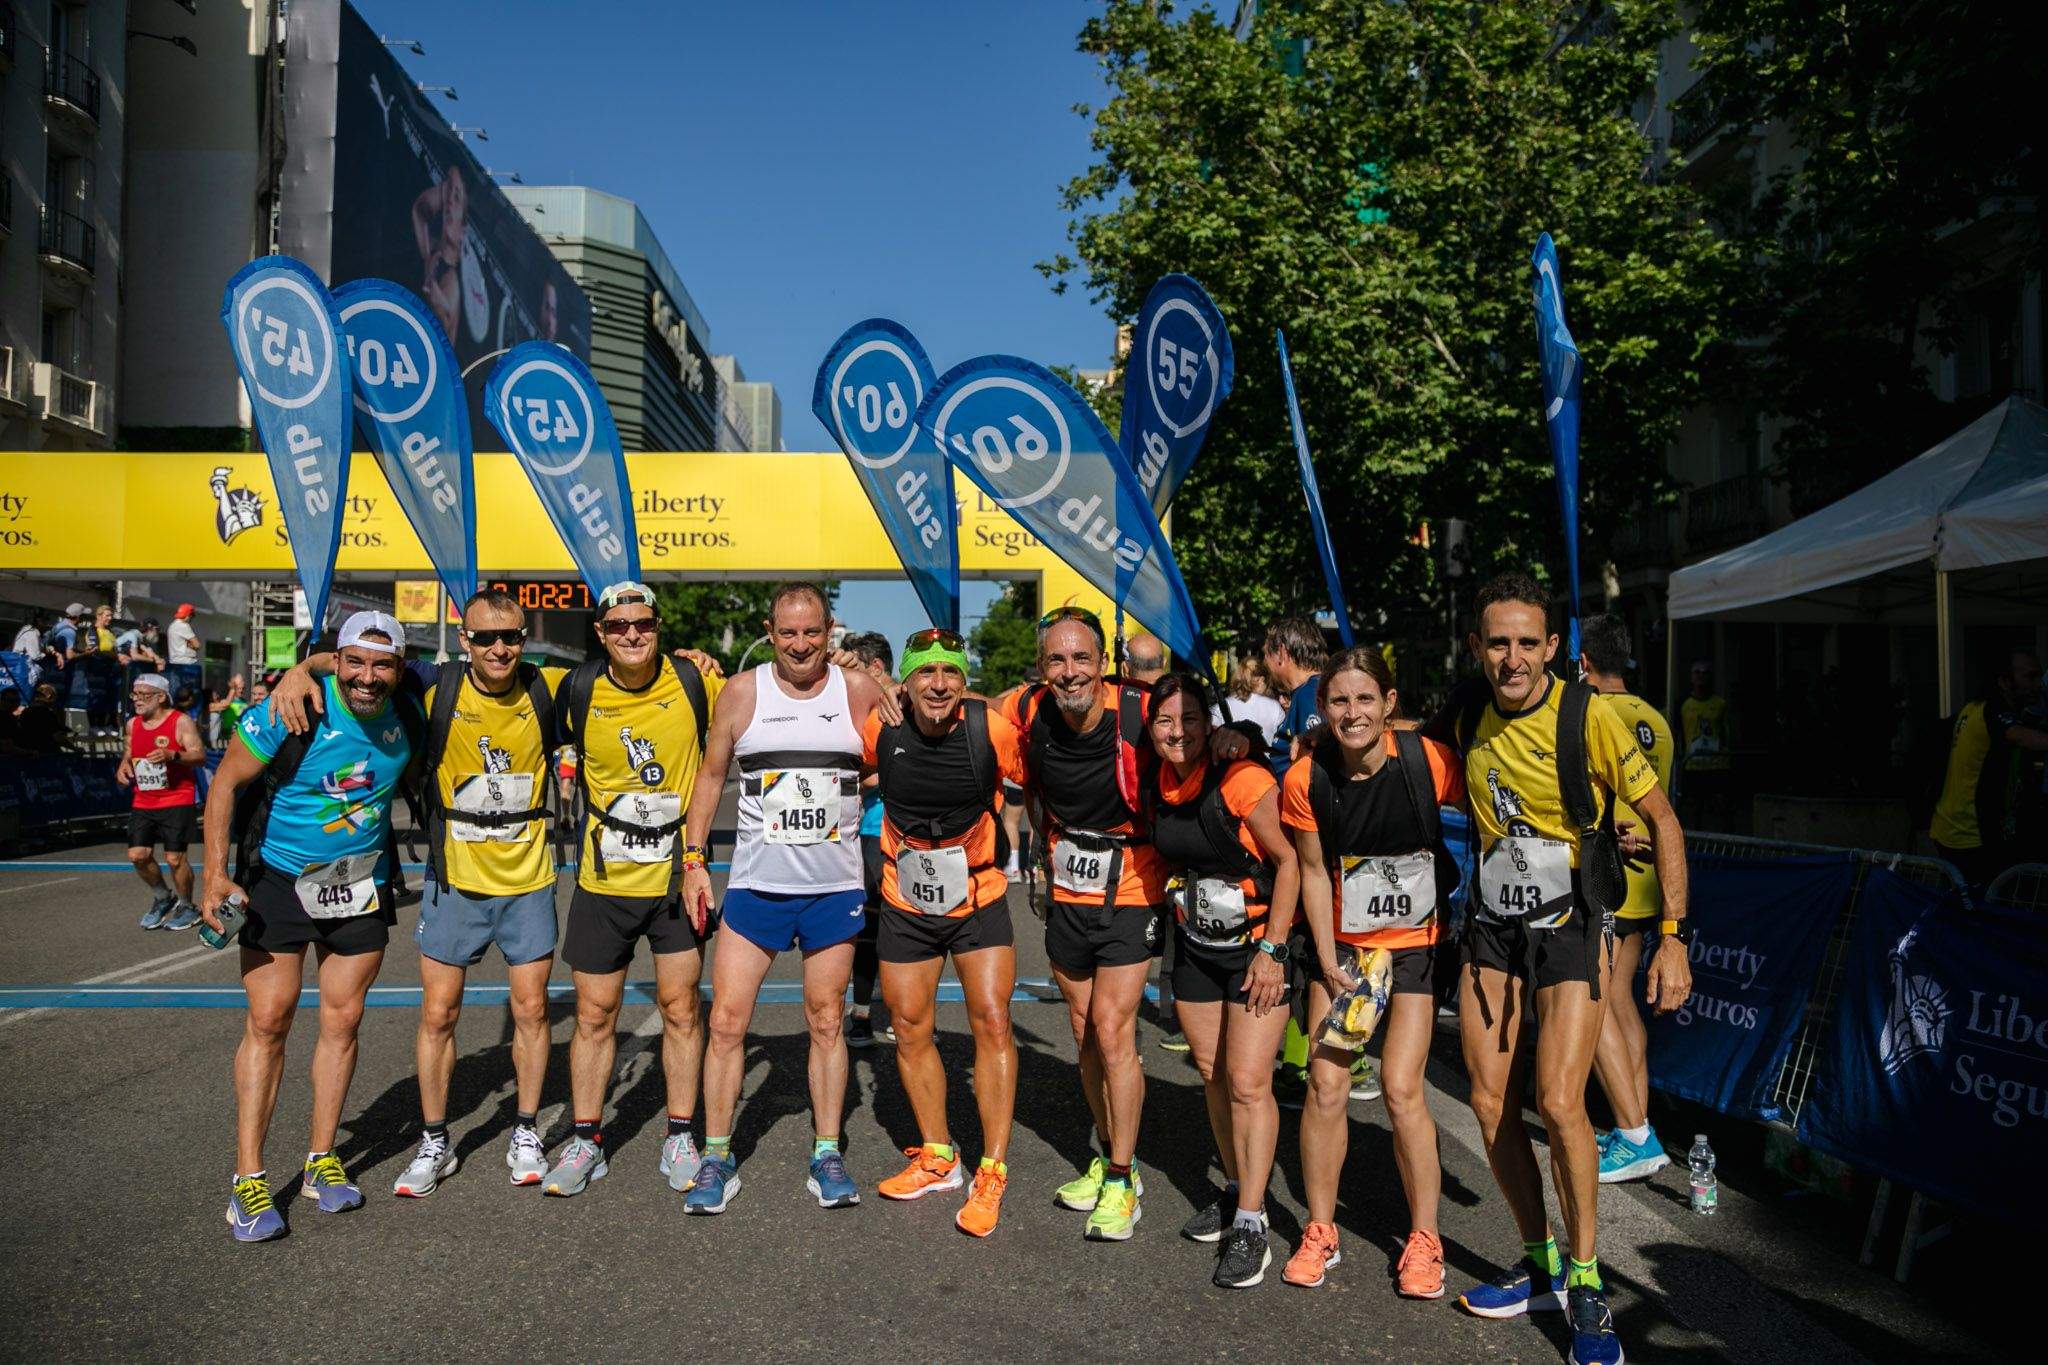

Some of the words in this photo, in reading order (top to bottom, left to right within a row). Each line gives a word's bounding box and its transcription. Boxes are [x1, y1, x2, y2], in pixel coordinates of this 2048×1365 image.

[1137, 429, 1170, 490] ub
[0, 492, 28, 521] ty
[275, 525, 382, 546] Sros
[639, 532, 730, 557] eguros
[975, 525, 1041, 556] Segu
[1638, 728, 1653, 744] 13
[644, 767, 661, 781] 13
[779, 808, 826, 831] 1458
[1512, 825, 1532, 837] 13
[1066, 854, 1100, 880] 448
[317, 883, 353, 907] 445
[912, 882, 945, 904] 451
[1499, 883, 1543, 911] 443
[1367, 894, 1411, 918] 449
[1688, 927, 1768, 991] berty
[1675, 991, 1759, 1031] guros
